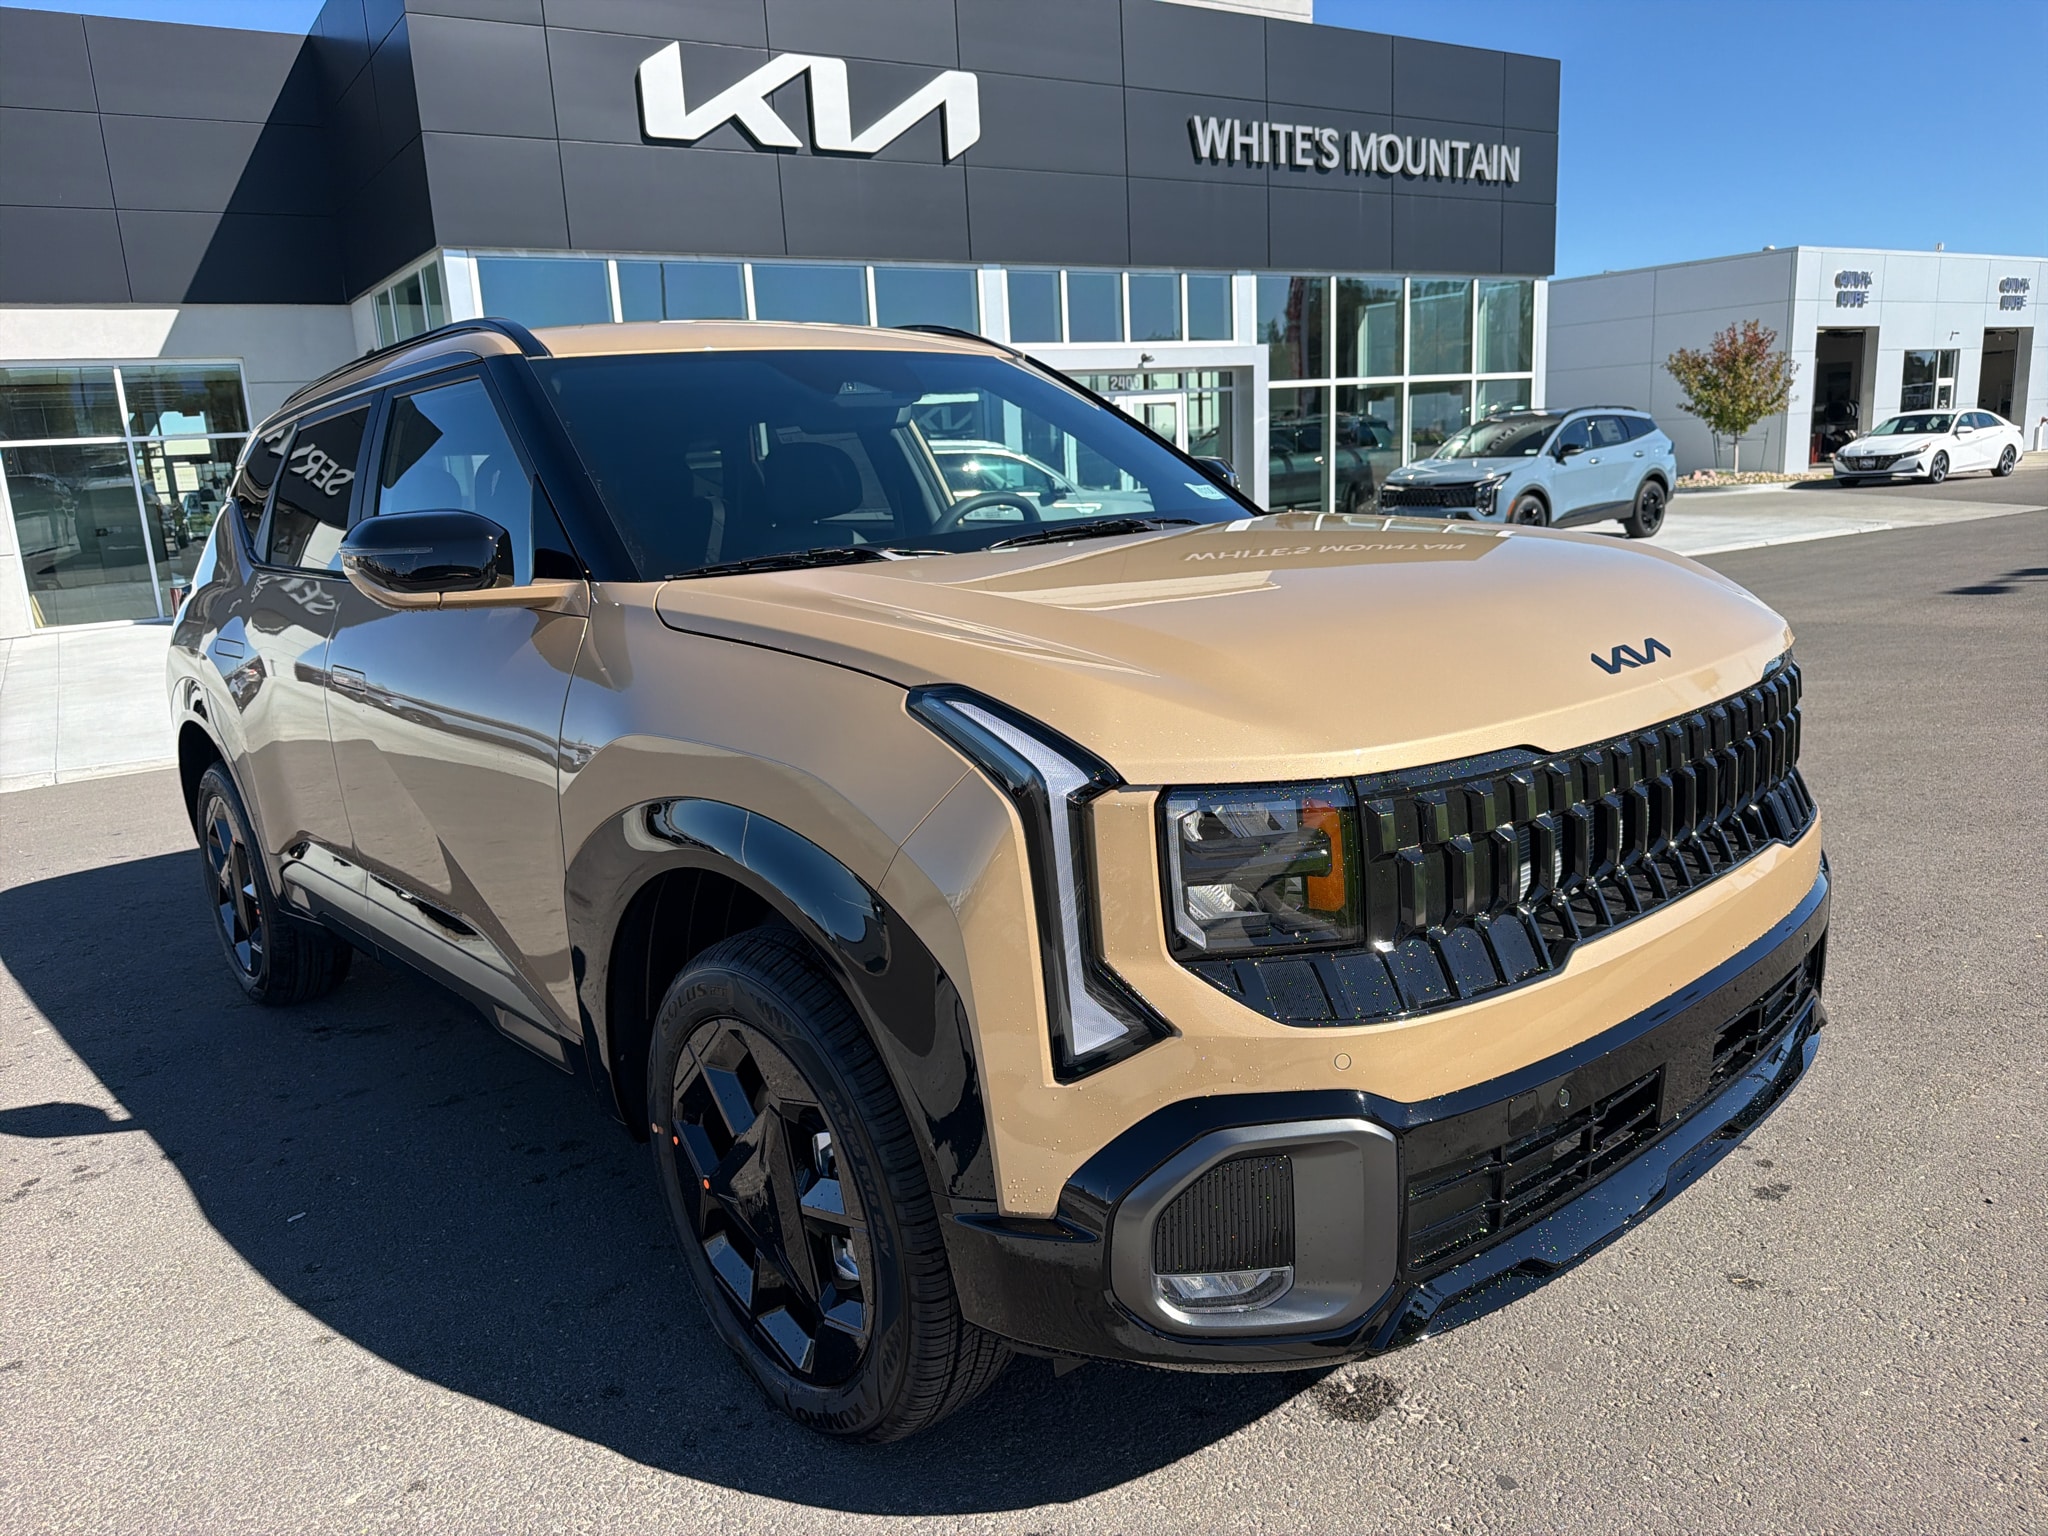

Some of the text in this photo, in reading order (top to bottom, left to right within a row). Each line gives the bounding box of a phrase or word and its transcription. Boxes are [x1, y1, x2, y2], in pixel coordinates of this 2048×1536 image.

[637, 40, 981, 162] KIA
[1190, 115, 1521, 184] WHITE'S MOUNTAIN
[1110, 375, 1141, 391] 2400
[1590, 637, 1672, 675] KIA
[662, 982, 708, 1032] SOLUS
[795, 1401, 867, 1431] KUMHO
